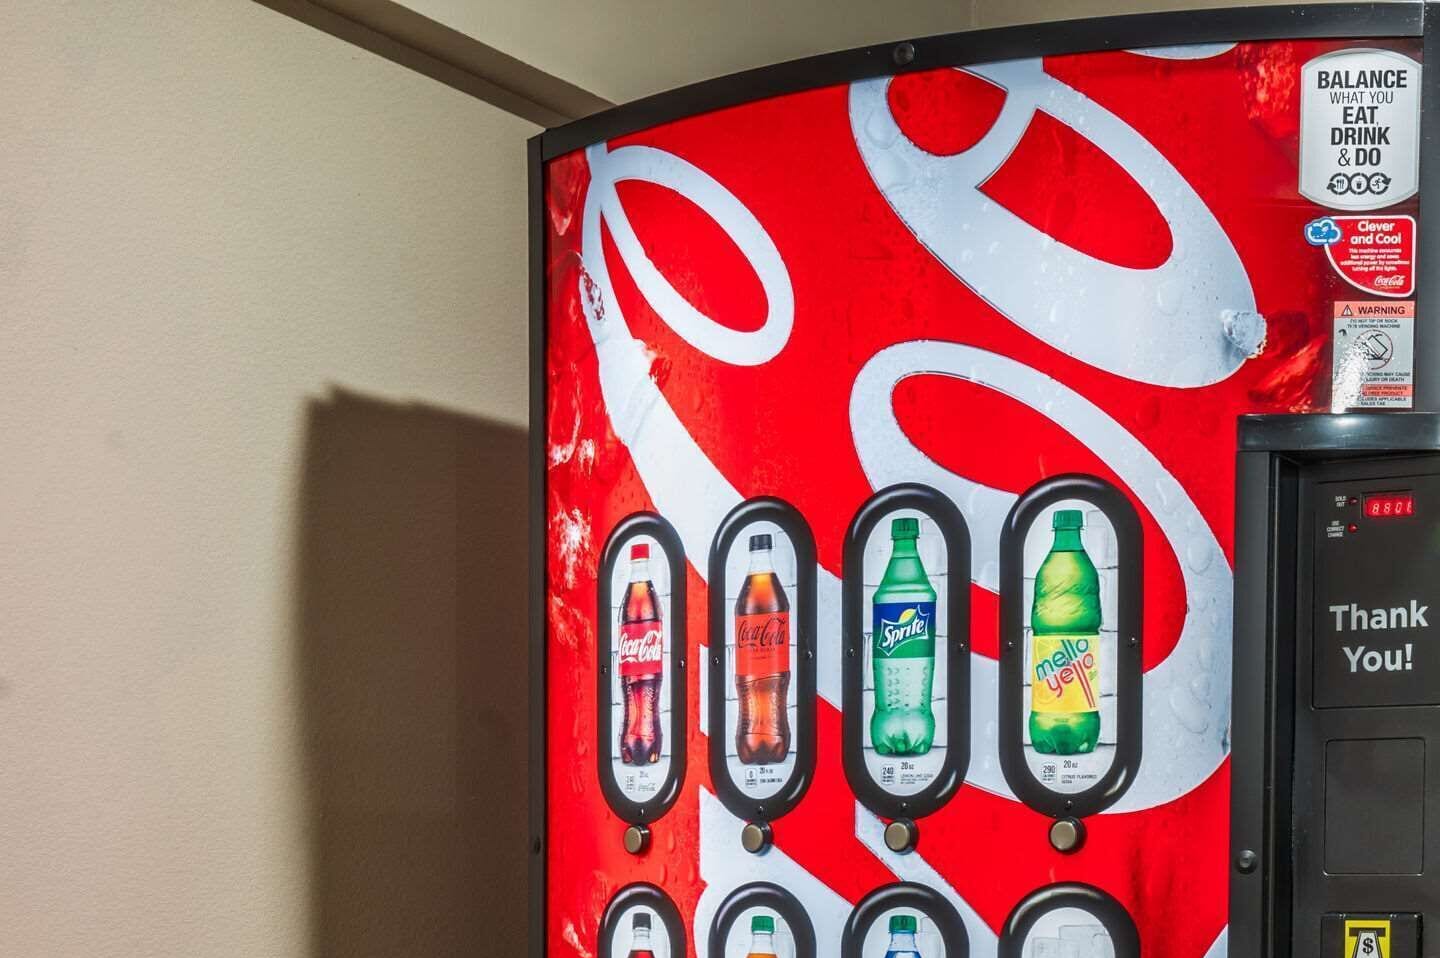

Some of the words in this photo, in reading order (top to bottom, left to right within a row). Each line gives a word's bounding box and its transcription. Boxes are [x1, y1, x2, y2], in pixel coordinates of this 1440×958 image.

[1317, 70, 1407, 89] BALANCE
[1330, 91, 1367, 104] WHAT
[1370, 91, 1393, 104] YOU
[1342, 106, 1379, 125] EAT,
[1331, 127, 1390, 145] DRINK
[1338, 148, 1351, 166] &
[1355, 148, 1381, 166] DO
[1357, 221, 1395, 232] Clever
[1351, 233, 1373, 244] and
[1375, 233, 1401, 244] Cool
[1358, 306, 1405, 315] WARNING
[1329, 600, 1429, 631] Thank
[737, 616, 786, 648] Coca-Cola
[882, 617, 925, 647] Sprite
[619, 630, 662, 664] Coca-Cola
[1036, 638, 1088, 681] mello
[1343, 644, 1413, 672] You!
[1047, 653, 1096, 708] yello
[1063, 760, 1071, 769] 20
